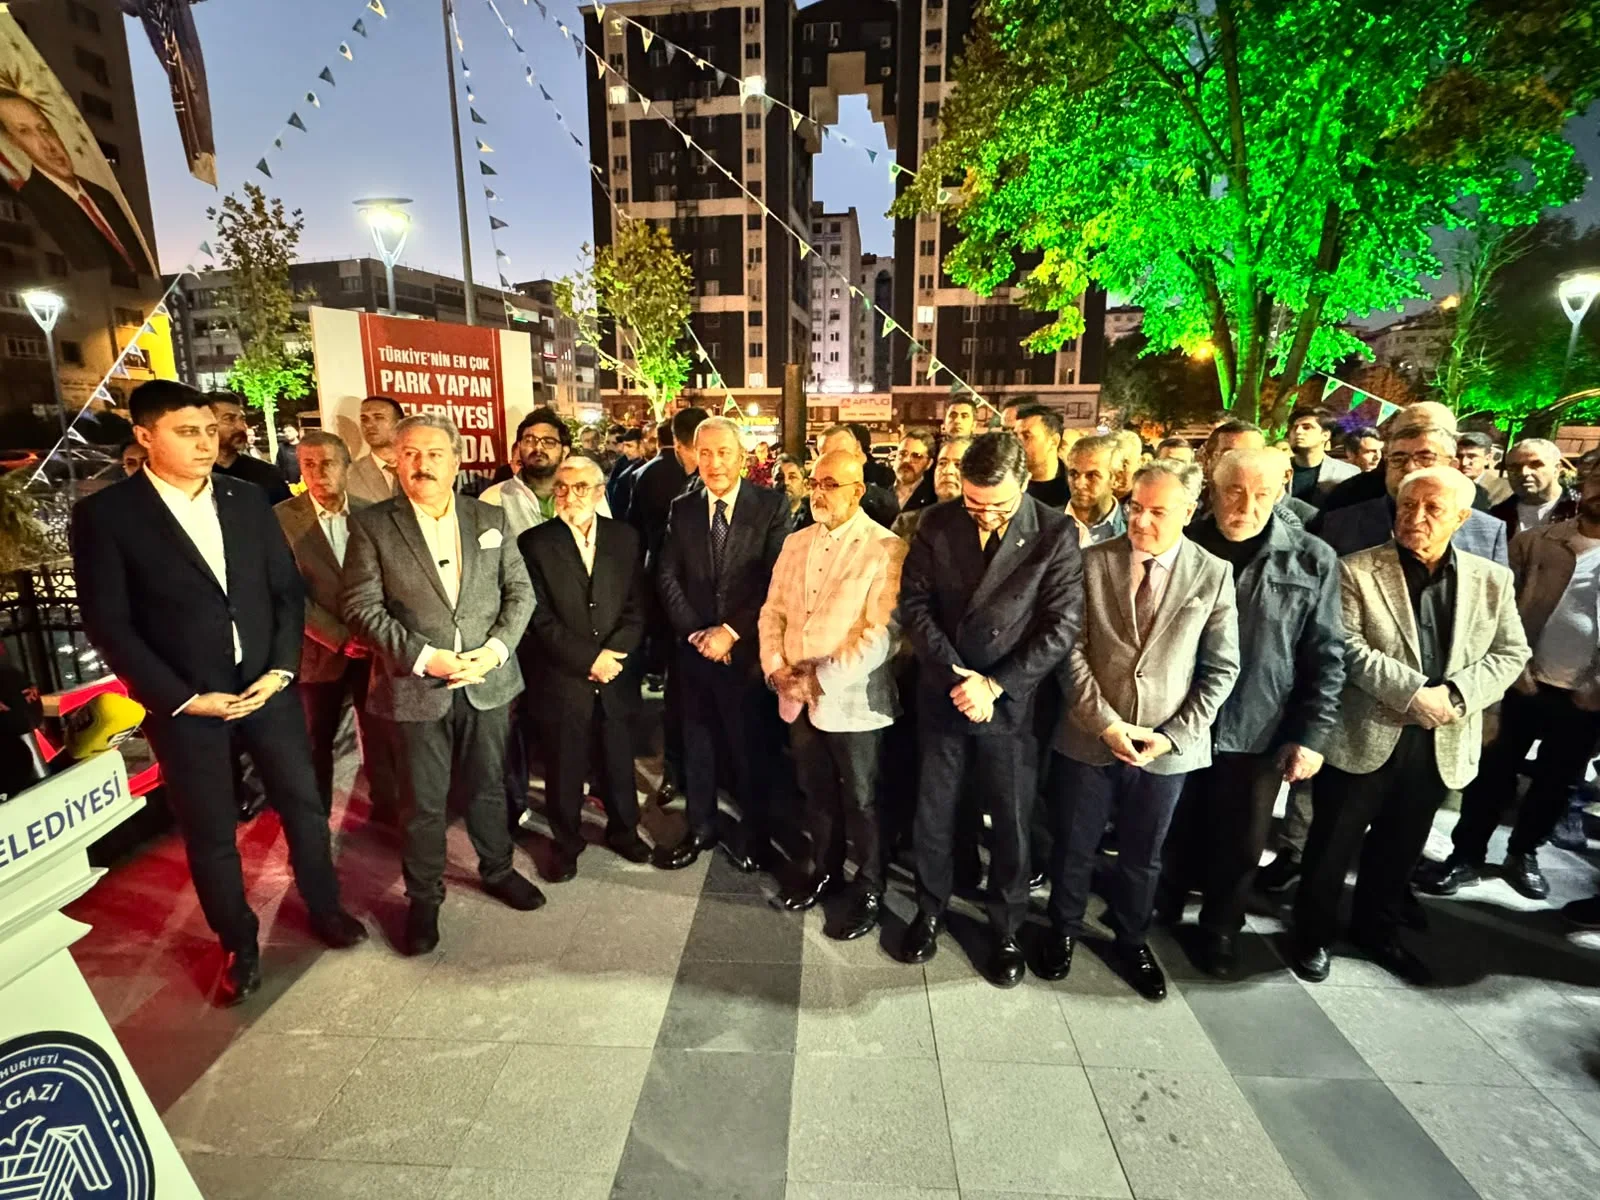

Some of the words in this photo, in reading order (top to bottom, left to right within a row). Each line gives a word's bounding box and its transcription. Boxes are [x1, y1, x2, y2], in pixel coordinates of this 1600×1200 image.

[378, 345, 451, 367] TÜRKİYE'NİN
[453, 354, 467, 368] EN
[469, 356, 490, 371] ÇOK
[380, 369, 432, 394] PARK
[435, 373, 492, 398] YAPAN
[399, 400, 494, 430] EİYESİ
[0, 1052, 59, 1080] HURİYETİ
[0, 1081, 64, 1115] GAZİ
